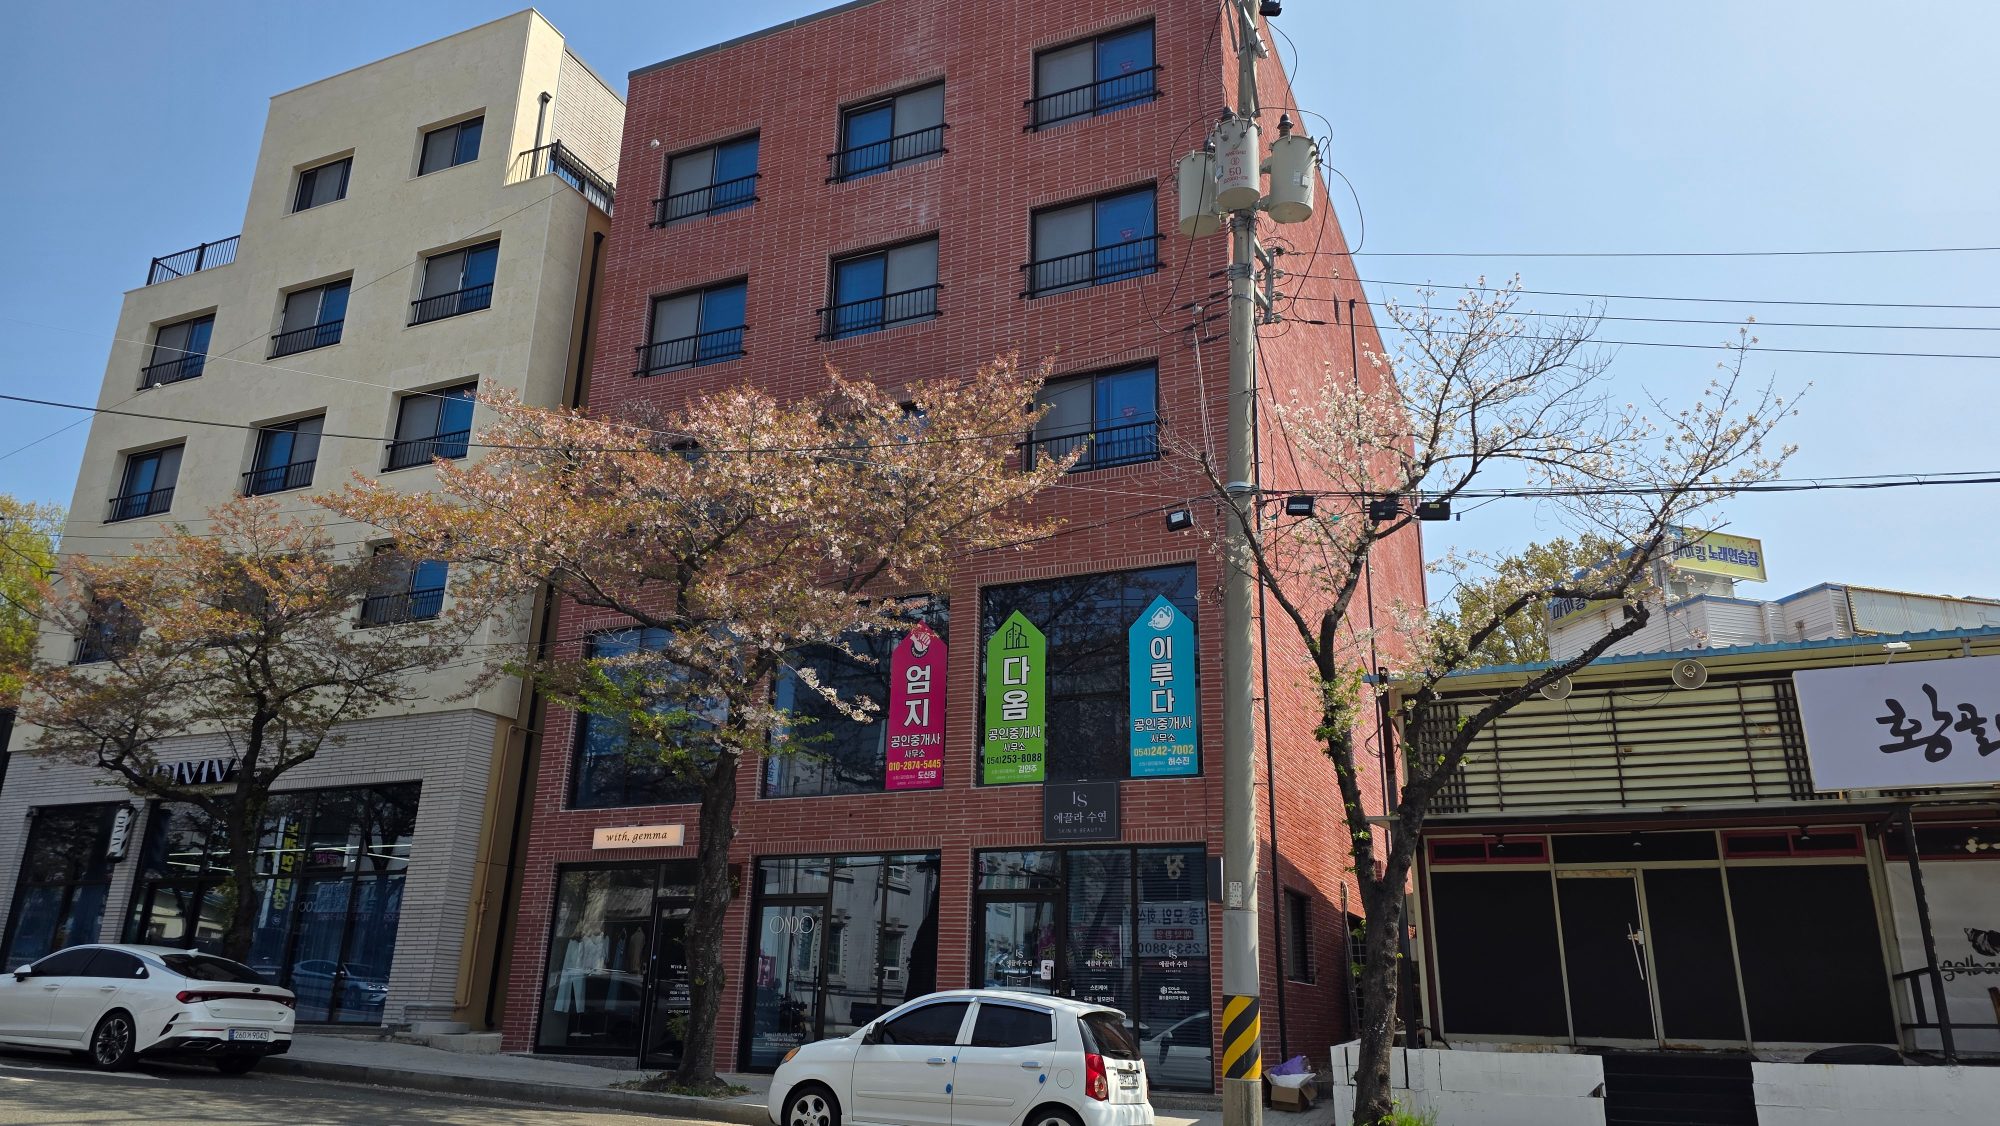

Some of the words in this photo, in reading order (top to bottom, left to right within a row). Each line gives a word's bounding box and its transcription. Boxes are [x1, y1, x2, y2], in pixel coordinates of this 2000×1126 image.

[1708, 544, 1760, 568] 노래연습장
[1149, 635, 1175, 713] 이루다
[903, 664, 931, 727] 엄지
[1002, 655, 1030, 721] 다옴
[1133, 715, 1192, 731] 공인중개사
[1875, 683, 2000, 763] 황골
[890, 732, 941, 748] 공인중개사
[988, 725, 1041, 741] 공인중개사
[1150, 733, 1176, 743] 사무소
[904, 749, 926, 758] 사무소
[1003, 742, 1026, 752] 사무소
[1086, 811, 1108, 823] 수연
[631, 831, 668, 843] gemma
[769, 915, 815, 934] ONDO
[1942, 954, 2000, 982] golba
